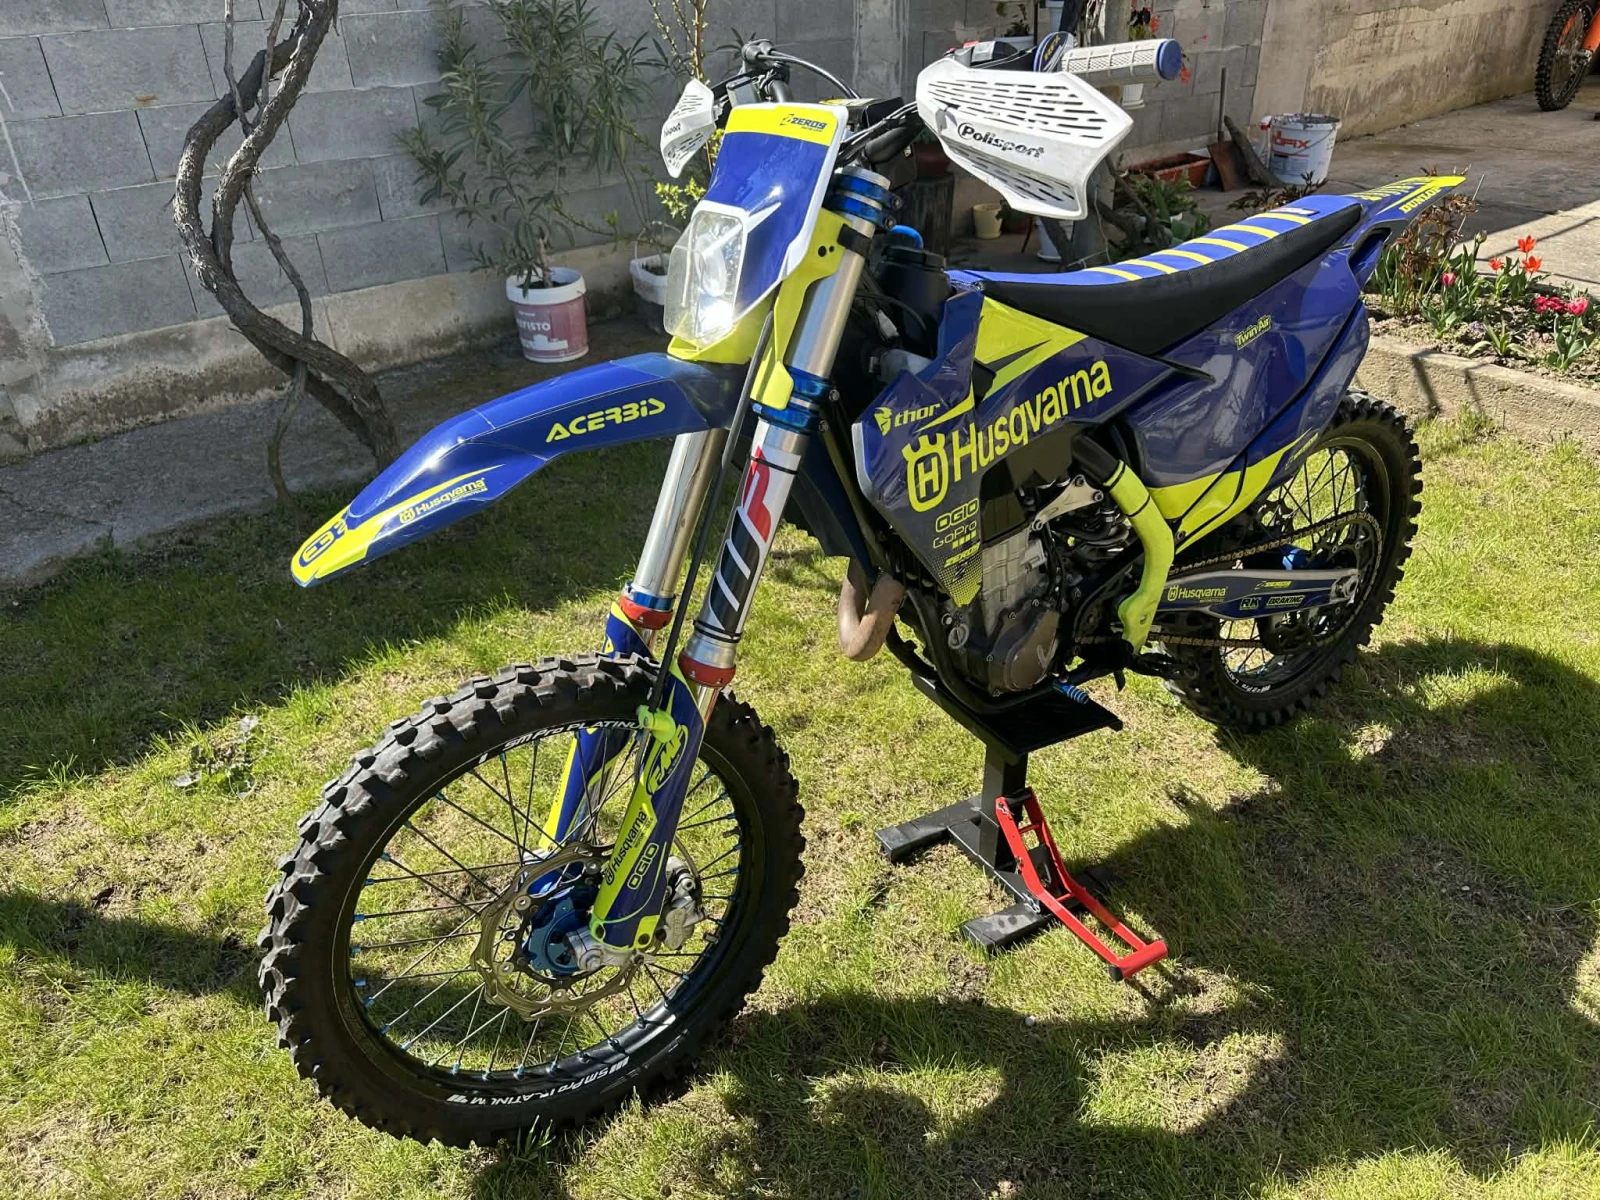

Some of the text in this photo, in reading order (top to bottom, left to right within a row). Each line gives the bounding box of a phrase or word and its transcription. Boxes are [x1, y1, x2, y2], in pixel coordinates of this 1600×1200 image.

[958, 122, 1045, 158] Polisport
[894, 403, 941, 427] thor
[952, 360, 1113, 482] Husqvarna
[415, 479, 486, 515] Husqvarna
[936, 498, 979, 532] OGIO
[933, 520, 977, 549] GoPro
[1178, 587, 1226, 600] Husqvarna
[1266, 595, 1305, 606] BRAKING
[567, 720, 645, 731] PLATINU
[612, 809, 647, 872] Husqvarna
[627, 843, 659, 890] OGIO
